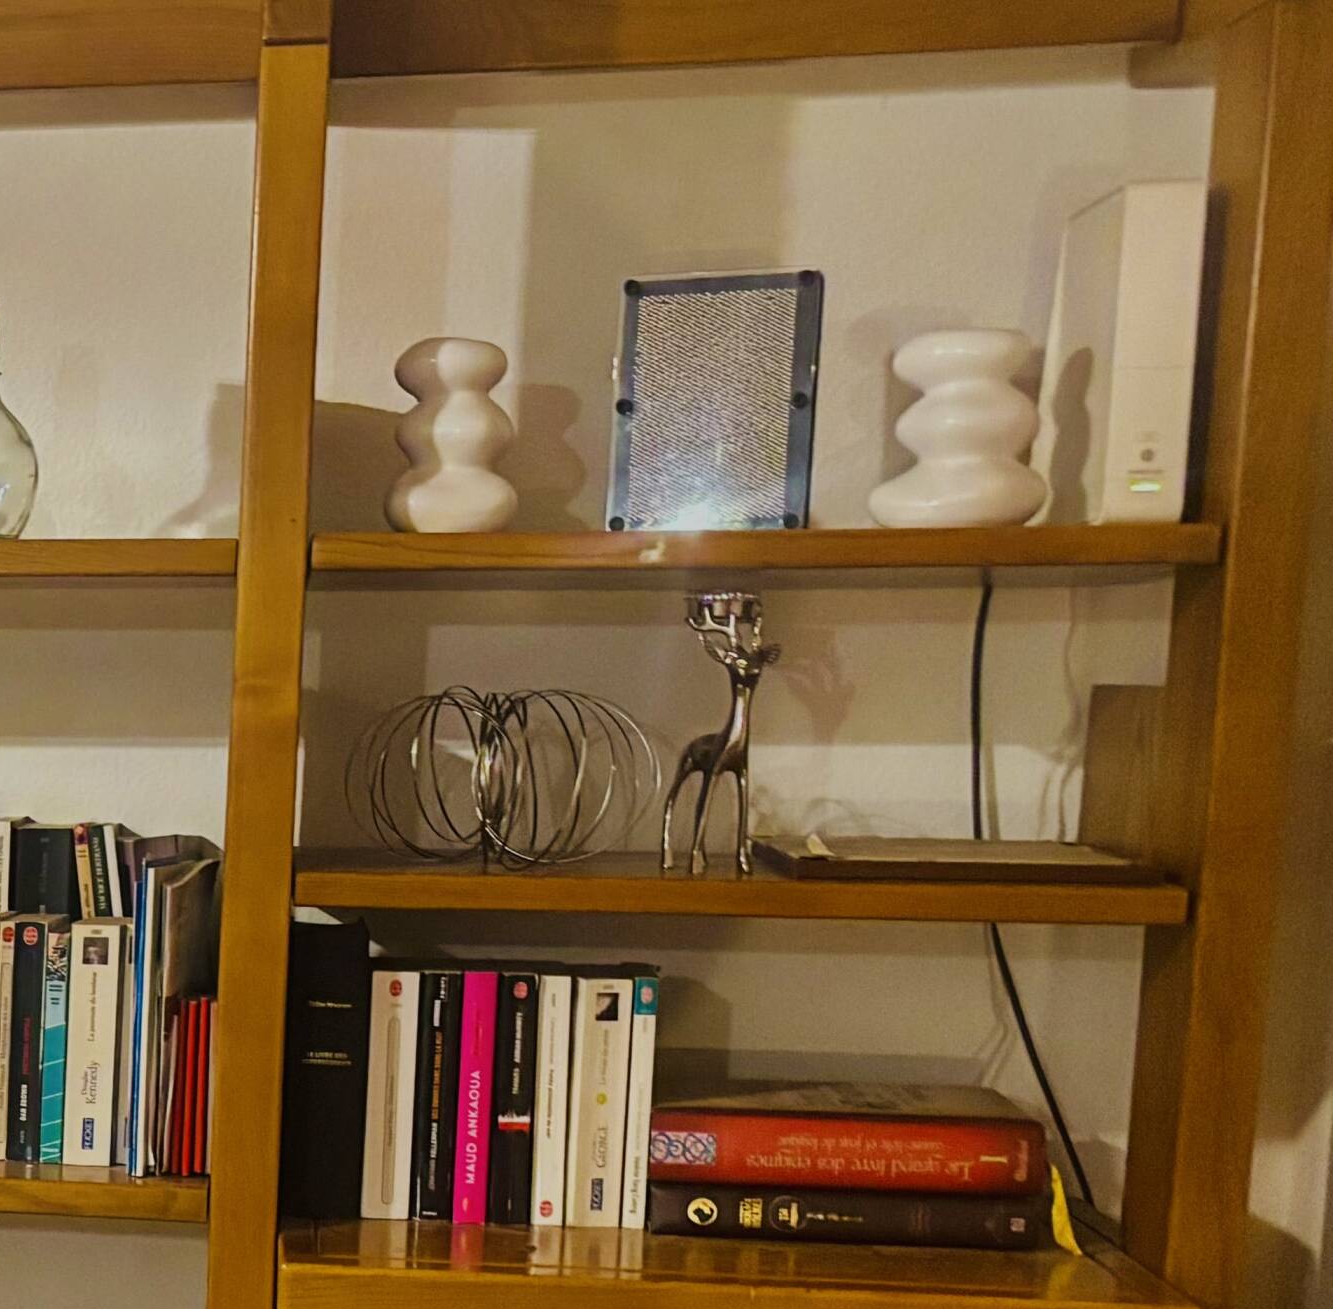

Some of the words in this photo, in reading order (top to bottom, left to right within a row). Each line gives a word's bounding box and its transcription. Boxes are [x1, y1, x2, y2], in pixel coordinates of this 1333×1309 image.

[20, 1084, 28, 1107] BROWN
[85, 1060, 100, 1105] Kennedy
[19, 1108, 28, 1121] DAN
[468, 1070, 481, 1138] ANKAOUA
[82, 1118, 94, 1150] POCKET
[465, 1142, 478, 1184] MAUD
